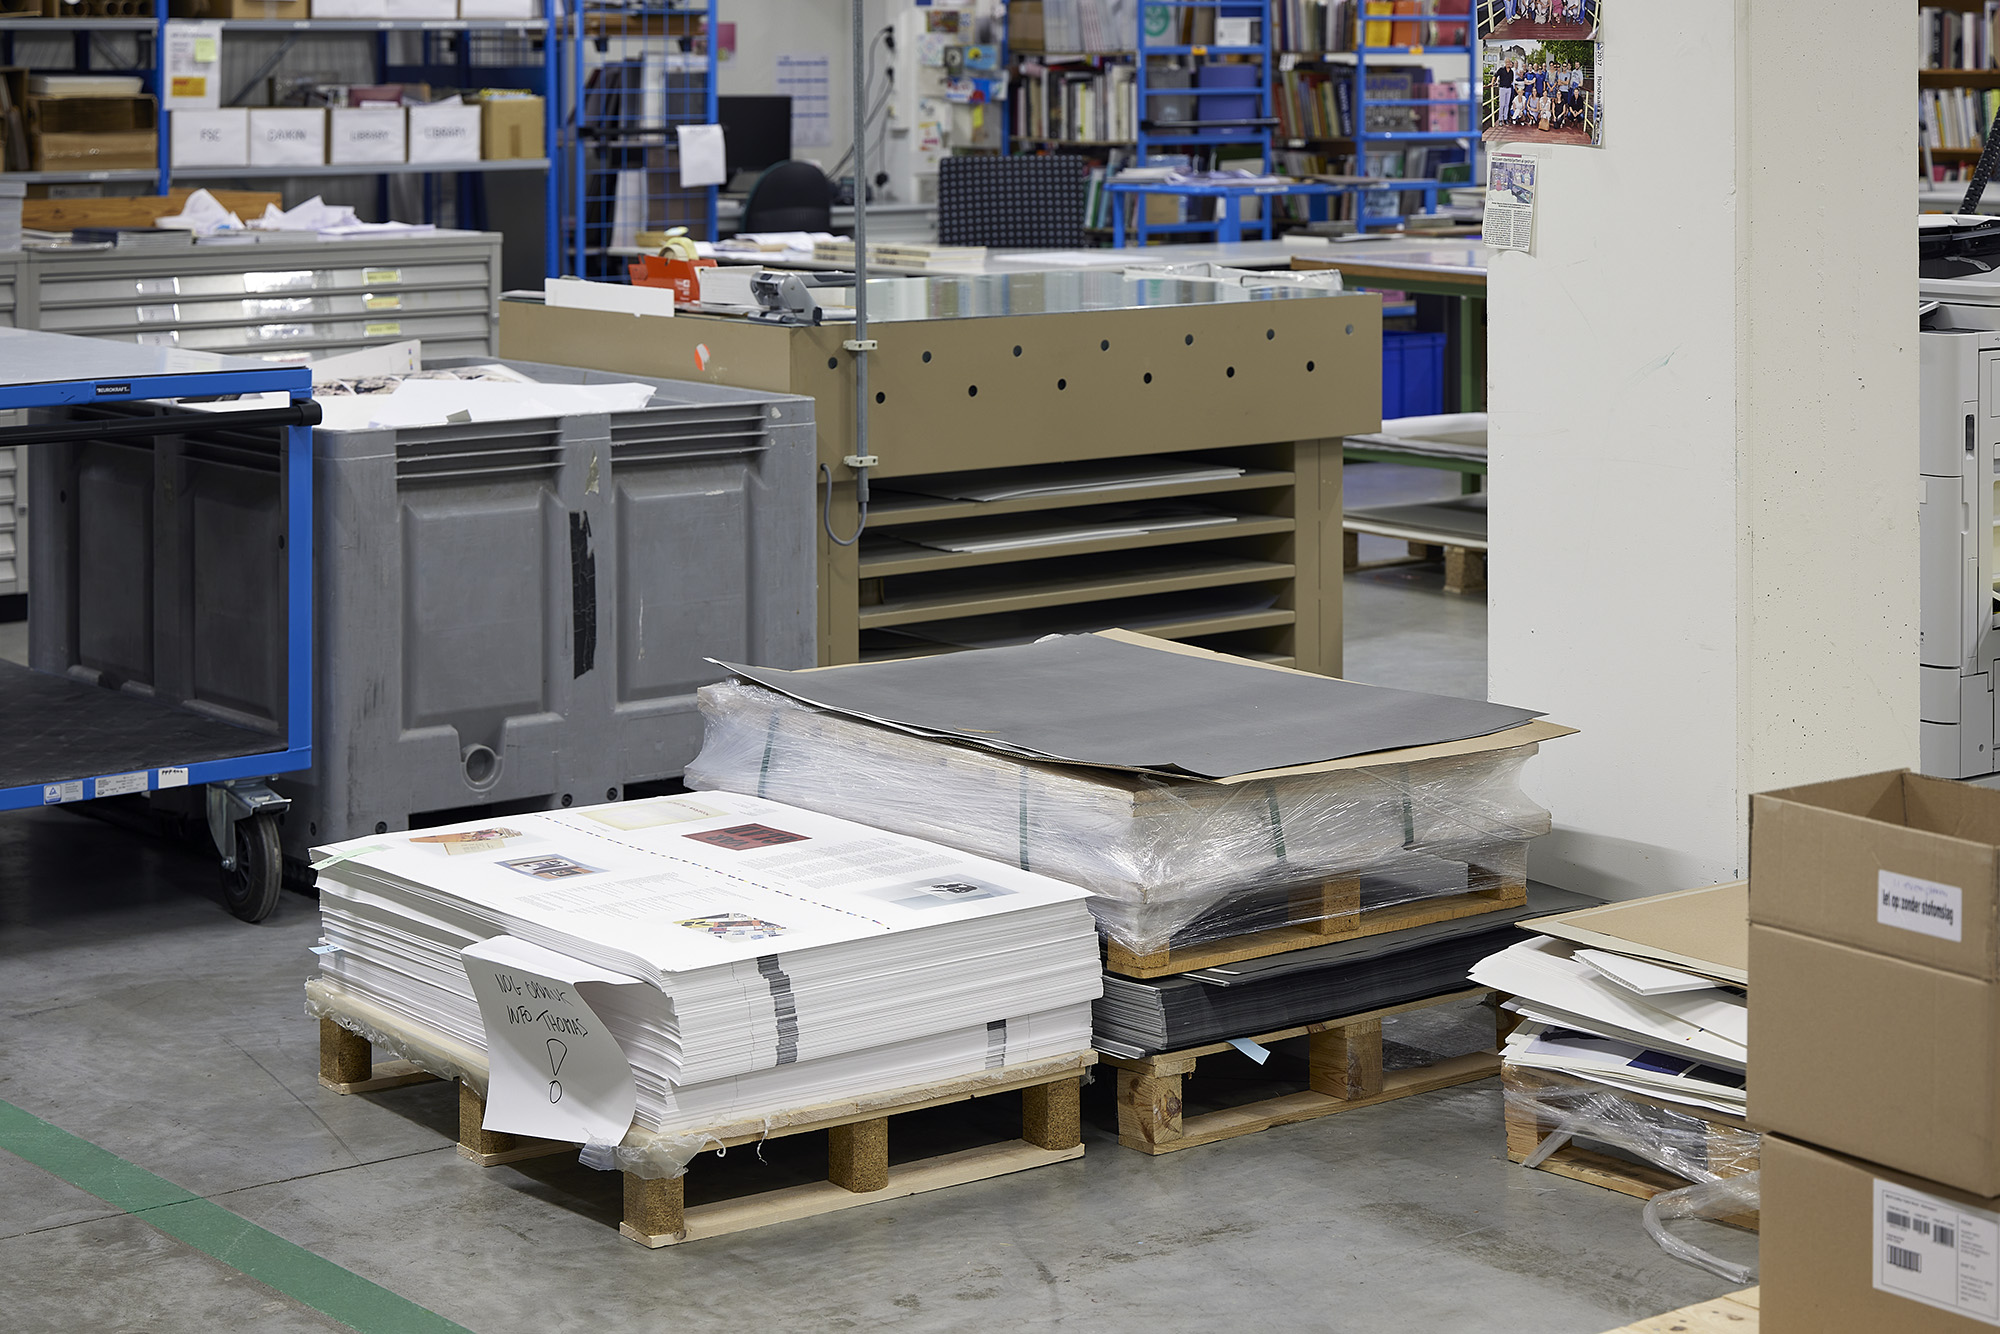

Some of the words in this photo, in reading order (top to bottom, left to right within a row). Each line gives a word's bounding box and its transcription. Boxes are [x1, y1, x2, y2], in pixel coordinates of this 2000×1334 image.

[200, 127, 222, 142] FSC
[350, 129, 390, 142] LIBRARY
[424, 126, 467, 140] LIBRARY
[1901, 896, 1920, 913] zonder
[506, 1005, 532, 1025] INFO
[535, 1009, 589, 1038] THOMAS
